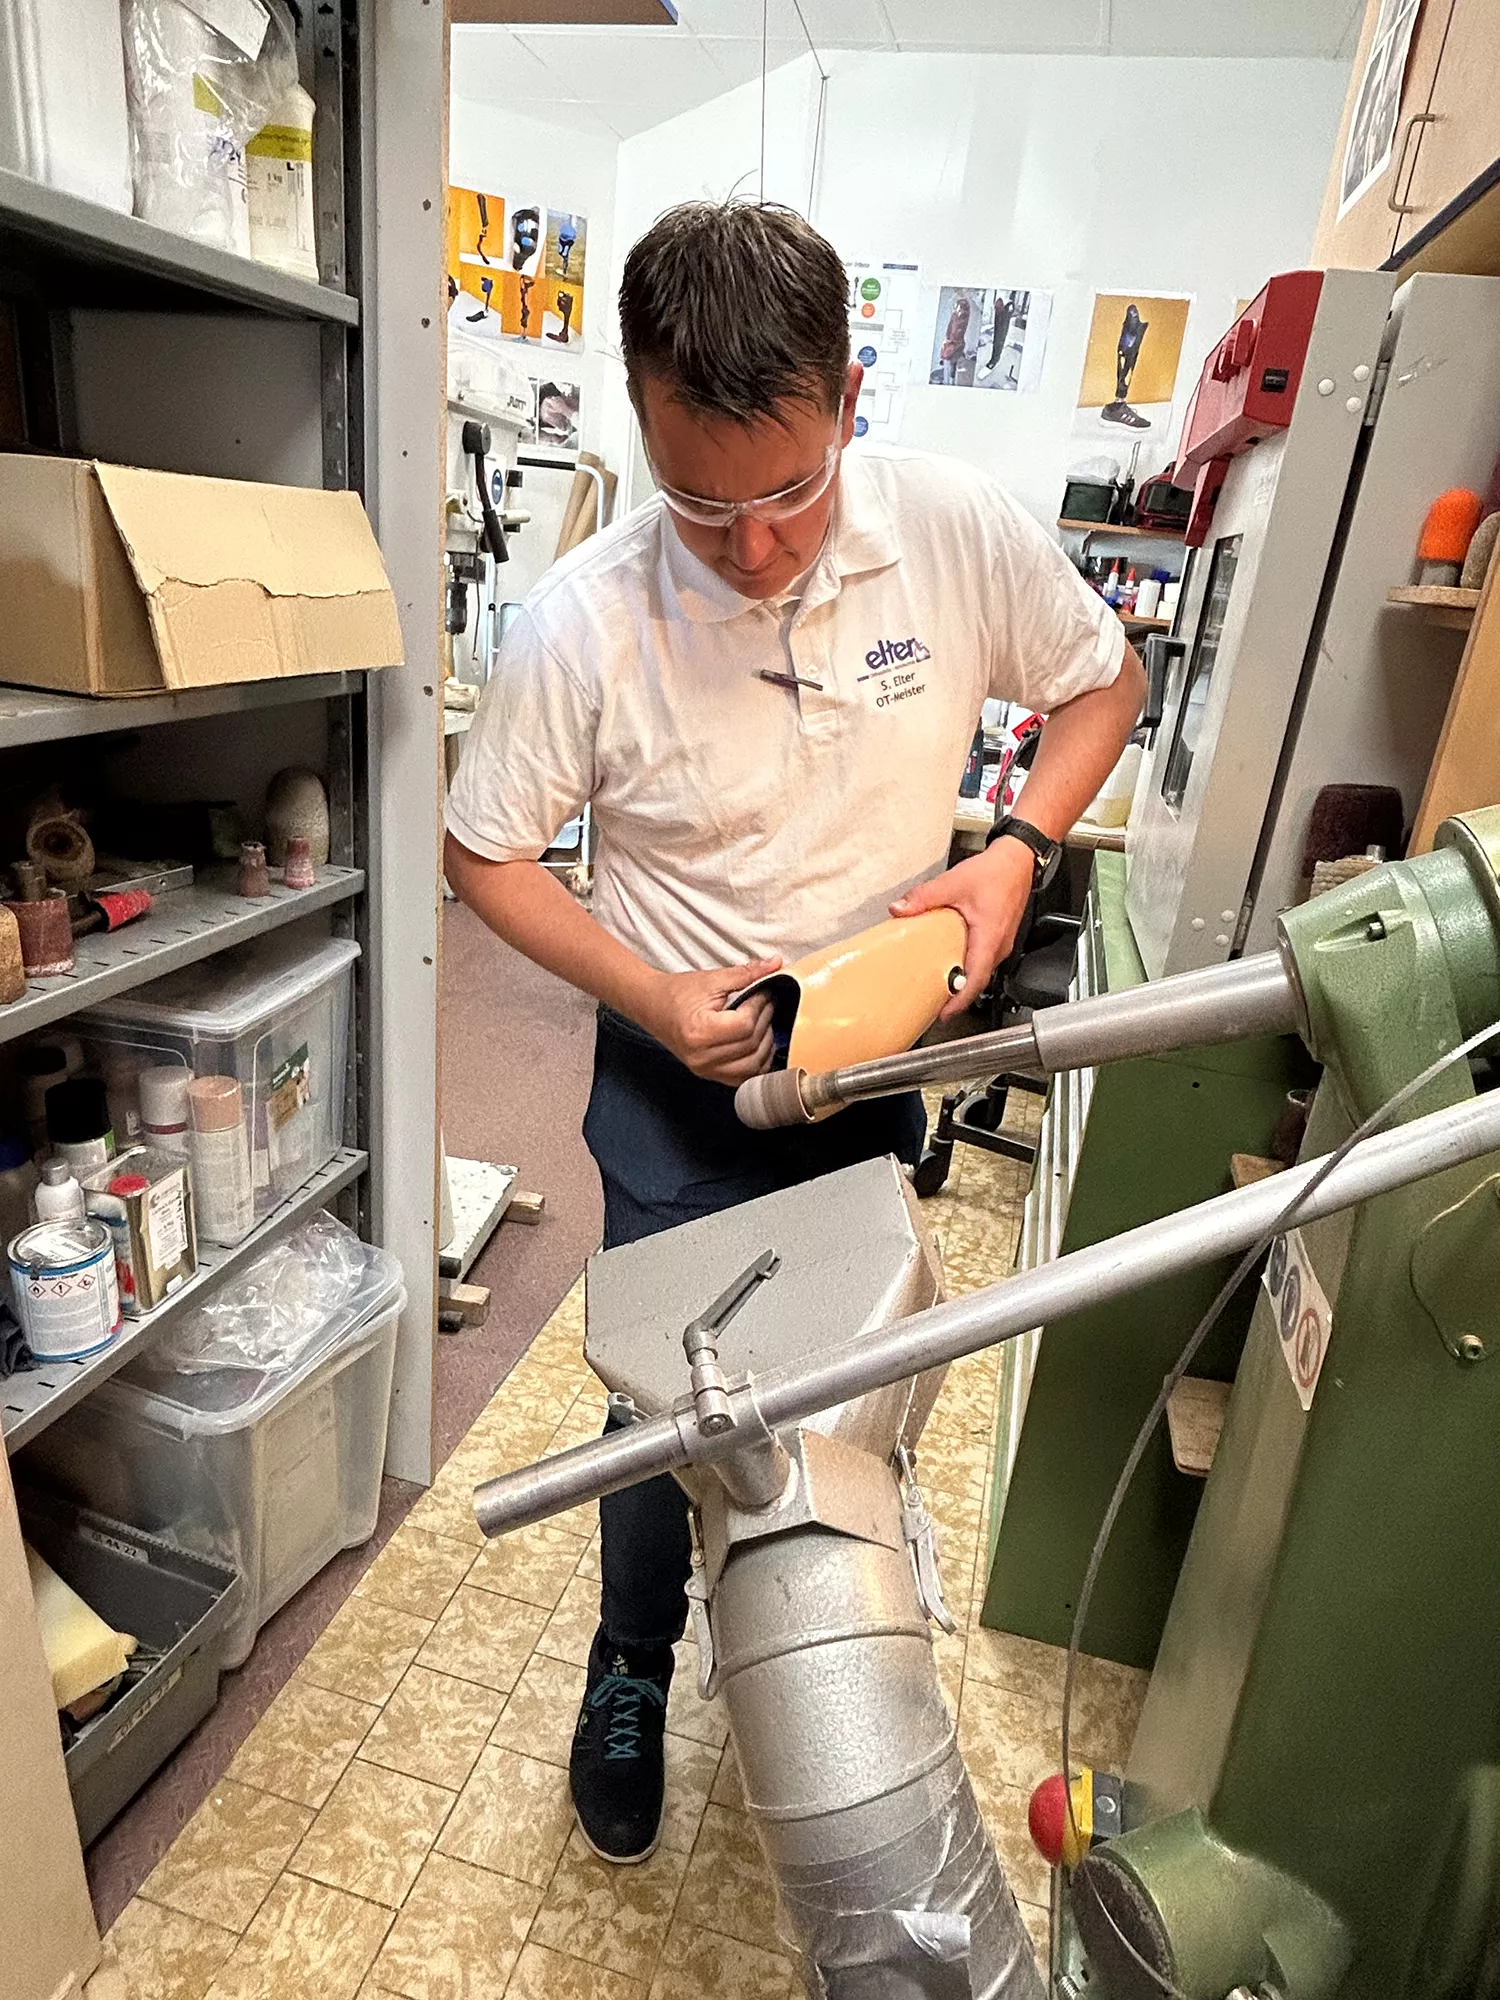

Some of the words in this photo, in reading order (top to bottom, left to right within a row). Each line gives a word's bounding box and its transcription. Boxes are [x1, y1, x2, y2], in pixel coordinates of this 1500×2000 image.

[865, 637, 916, 670] elter
[880, 679, 892, 691] S.
[893, 672, 916, 687] Elter
[876, 683, 926, 708] OT-Meister
